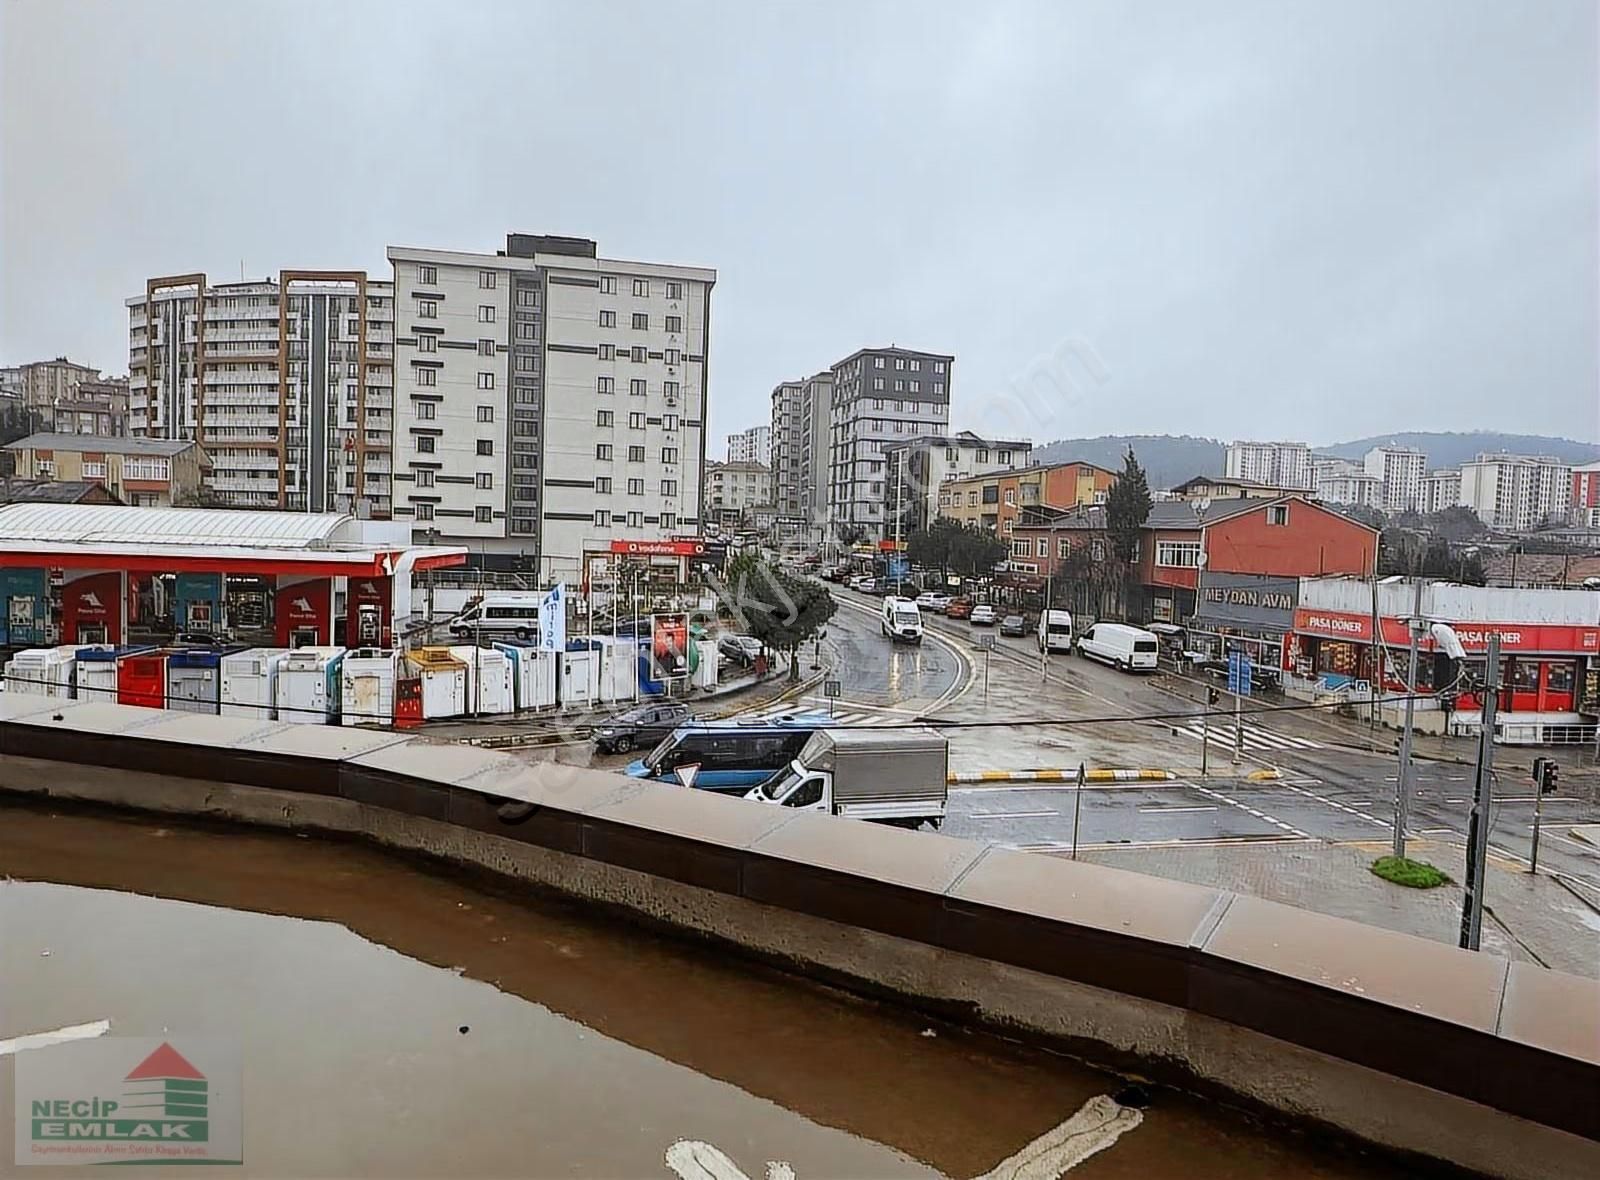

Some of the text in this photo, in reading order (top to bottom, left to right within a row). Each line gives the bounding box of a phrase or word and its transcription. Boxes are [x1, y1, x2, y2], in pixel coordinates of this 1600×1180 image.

[1205, 587, 1292, 610] MEYDAN AVM
[1331, 616, 1362, 633] DÖNER
[1456, 628, 1521, 646] PAŞA DNER
